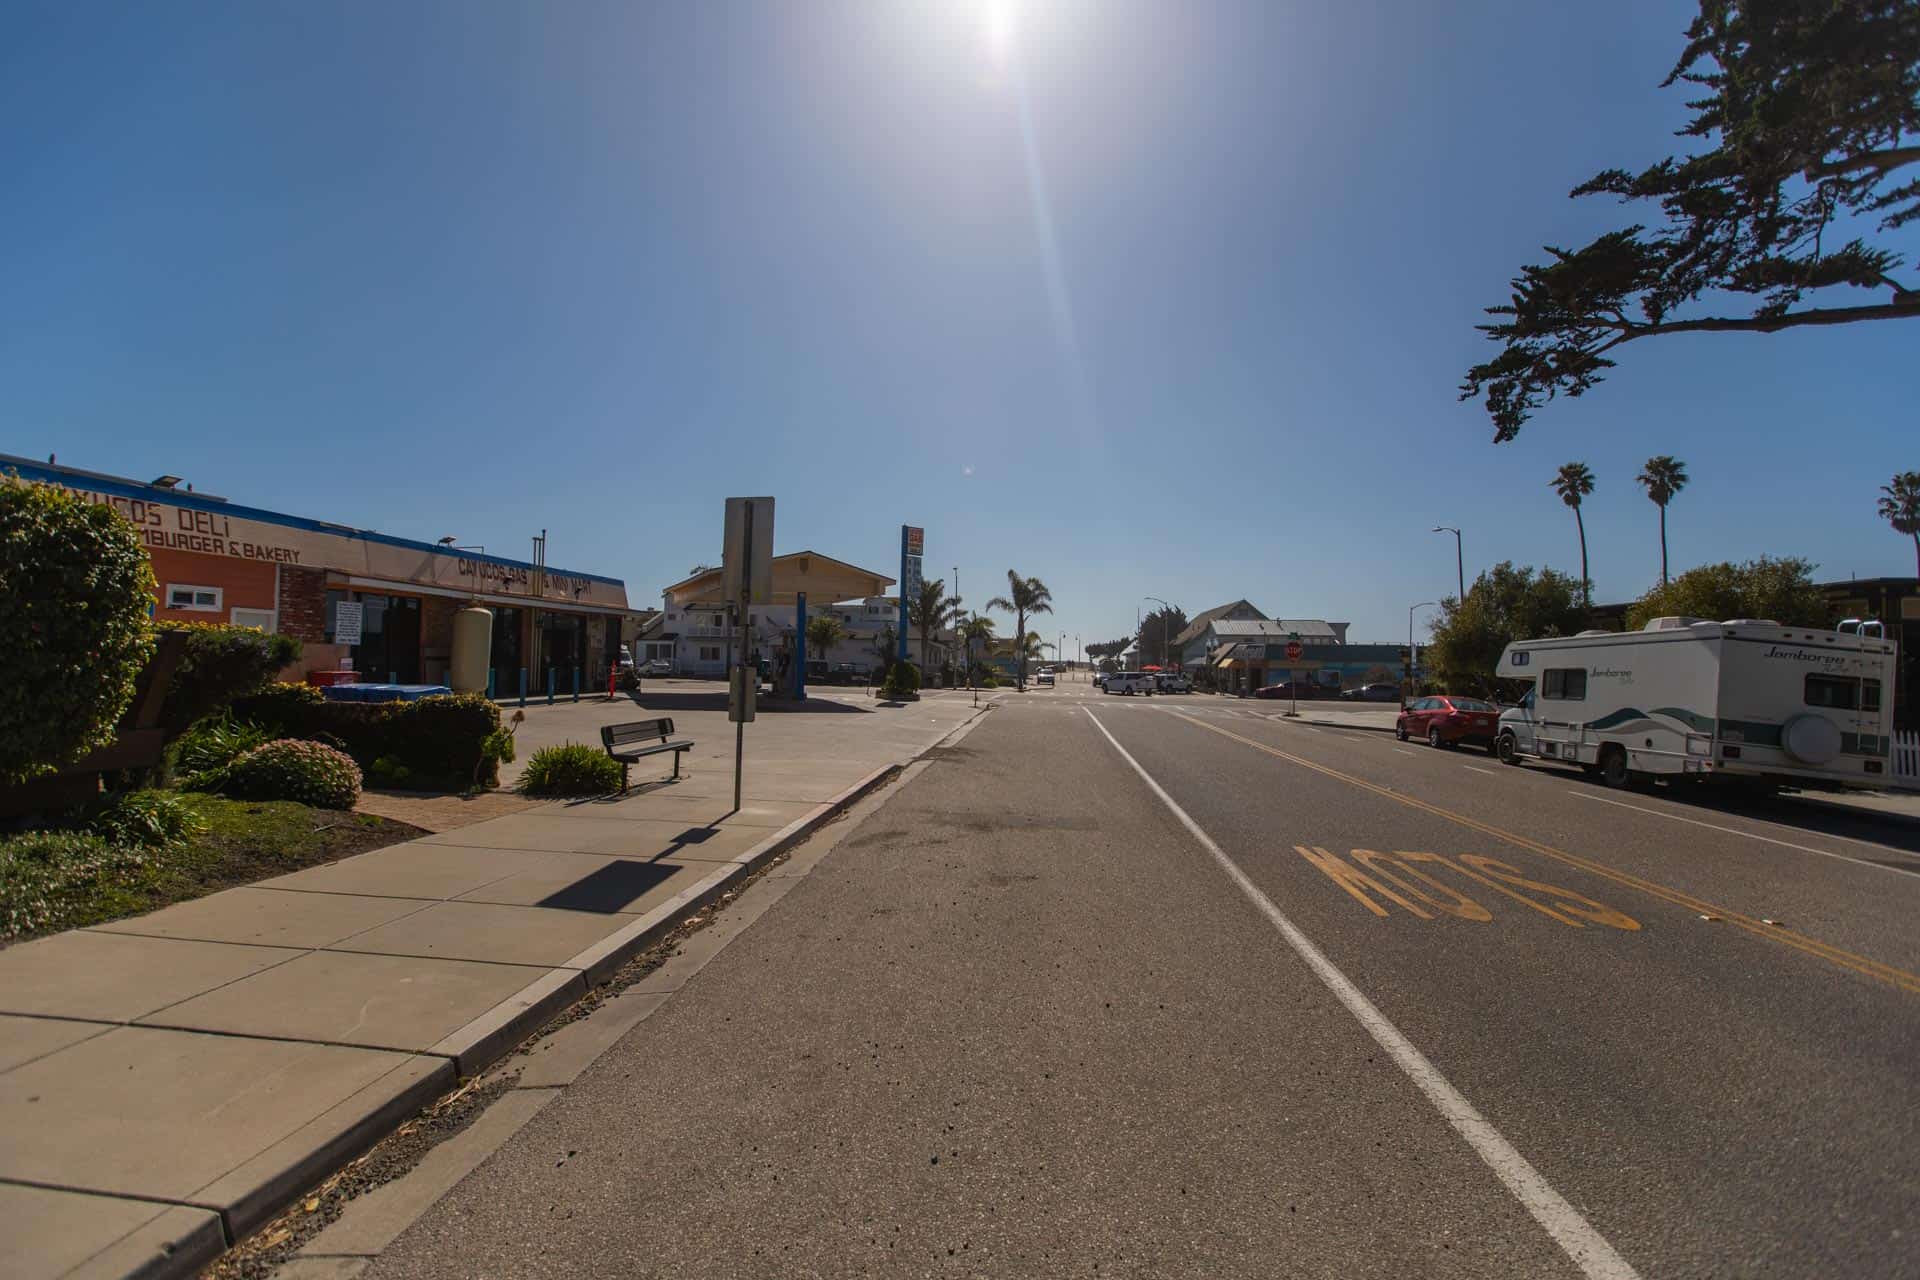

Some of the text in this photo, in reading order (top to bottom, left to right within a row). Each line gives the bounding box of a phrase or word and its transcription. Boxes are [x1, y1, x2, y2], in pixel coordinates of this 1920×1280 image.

[138, 528, 301, 564] MBURGER & BAKERY
[458, 558, 505, 581] CAYUCOS
[1763, 646, 1846, 665] Jamboree
